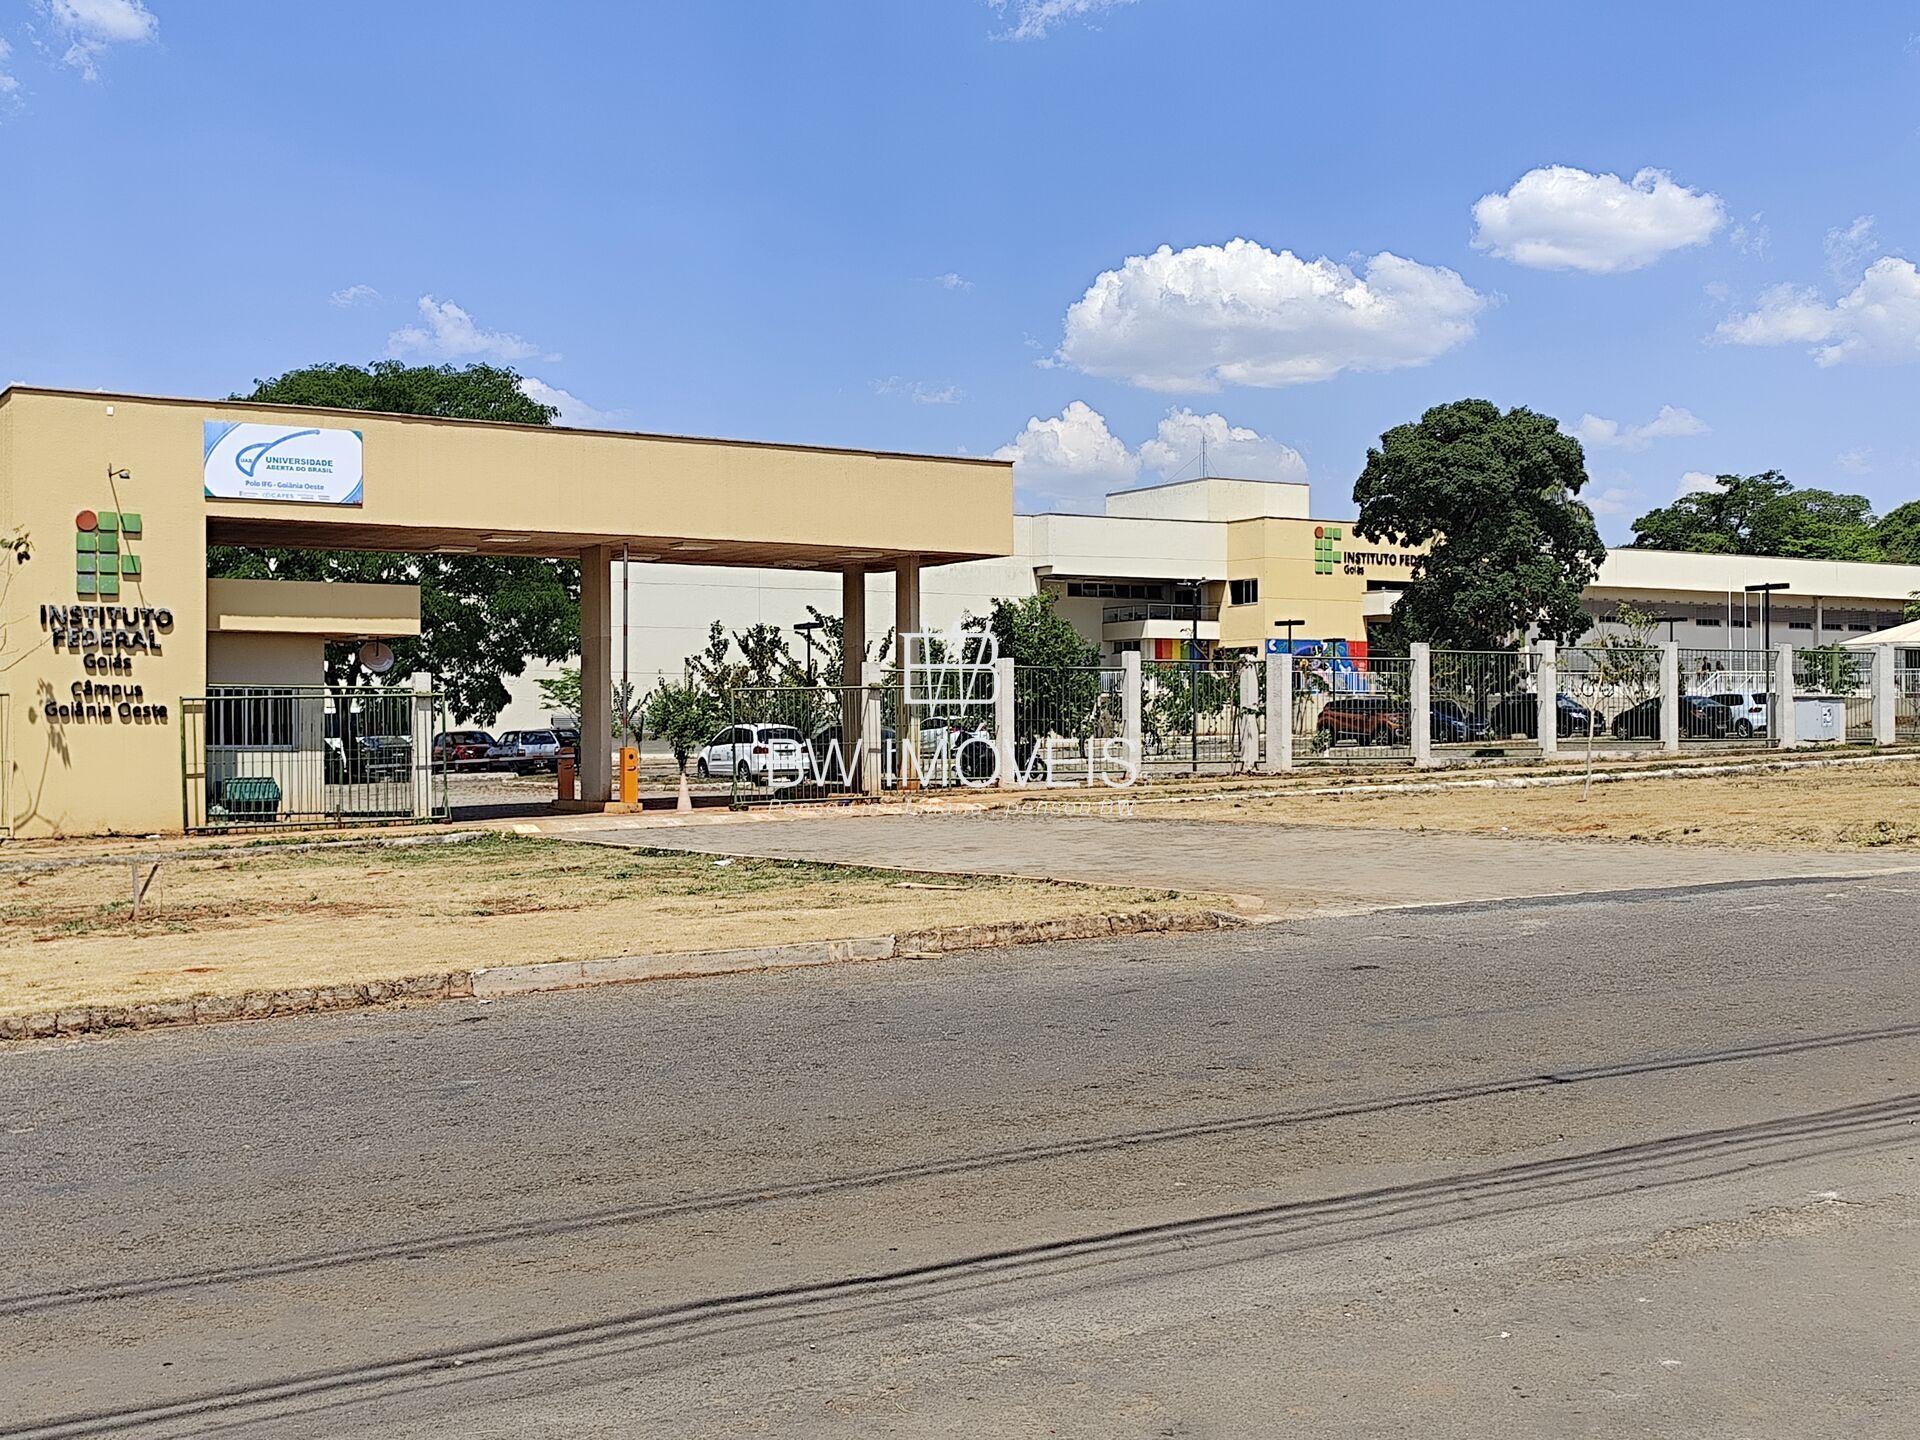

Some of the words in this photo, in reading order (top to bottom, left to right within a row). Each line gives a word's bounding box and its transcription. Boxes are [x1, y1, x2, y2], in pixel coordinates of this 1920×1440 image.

[265, 456, 333, 466] UNIVERSIDADE
[307, 466, 334, 474] BRASIL
[245, 479, 261, 488] Polo
[261, 480, 273, 488] IFG
[277, 481, 304, 489] Goiânia
[305, 482, 325, 491] Oeste
[1343, 551, 1397, 566] INSTITUTO
[40, 605, 174, 631] INSTITUTO
[52, 628, 163, 651] FEDERAL
[83, 653, 133, 670] Goiás
[71, 680, 144, 700] Câmpus
[44, 701, 112, 717] Goiânia
[117, 702, 169, 719] Oeste
